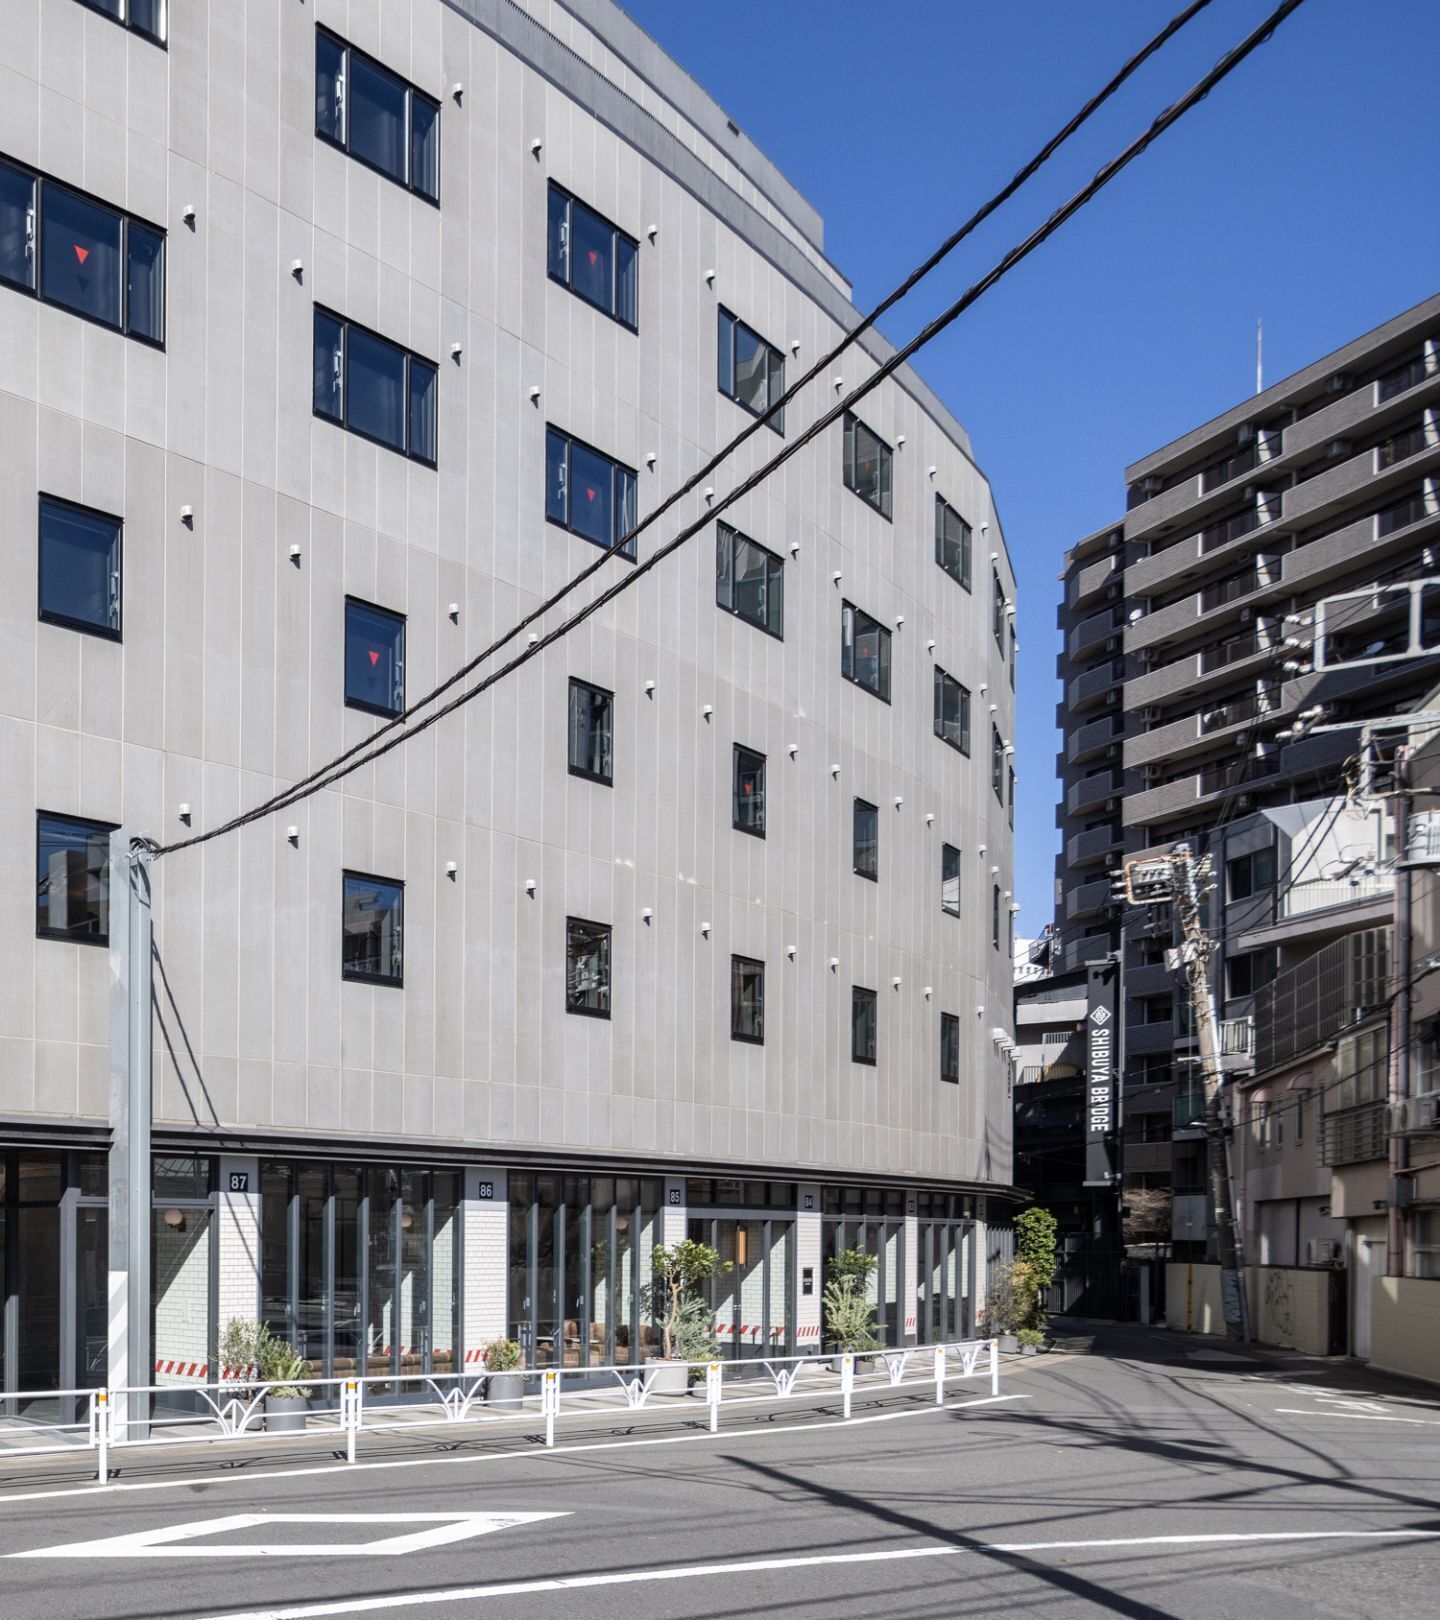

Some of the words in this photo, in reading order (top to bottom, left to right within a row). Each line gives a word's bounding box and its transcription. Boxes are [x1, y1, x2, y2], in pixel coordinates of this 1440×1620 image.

[1091, 1028, 1110, 1083] SHIBUYA
[1090, 1087, 1109, 1132] BRIDGE
[231, 1175, 246, 1189] 87
[480, 1184, 493, 1197] 86
[670, 1191, 680, 1203] 85
